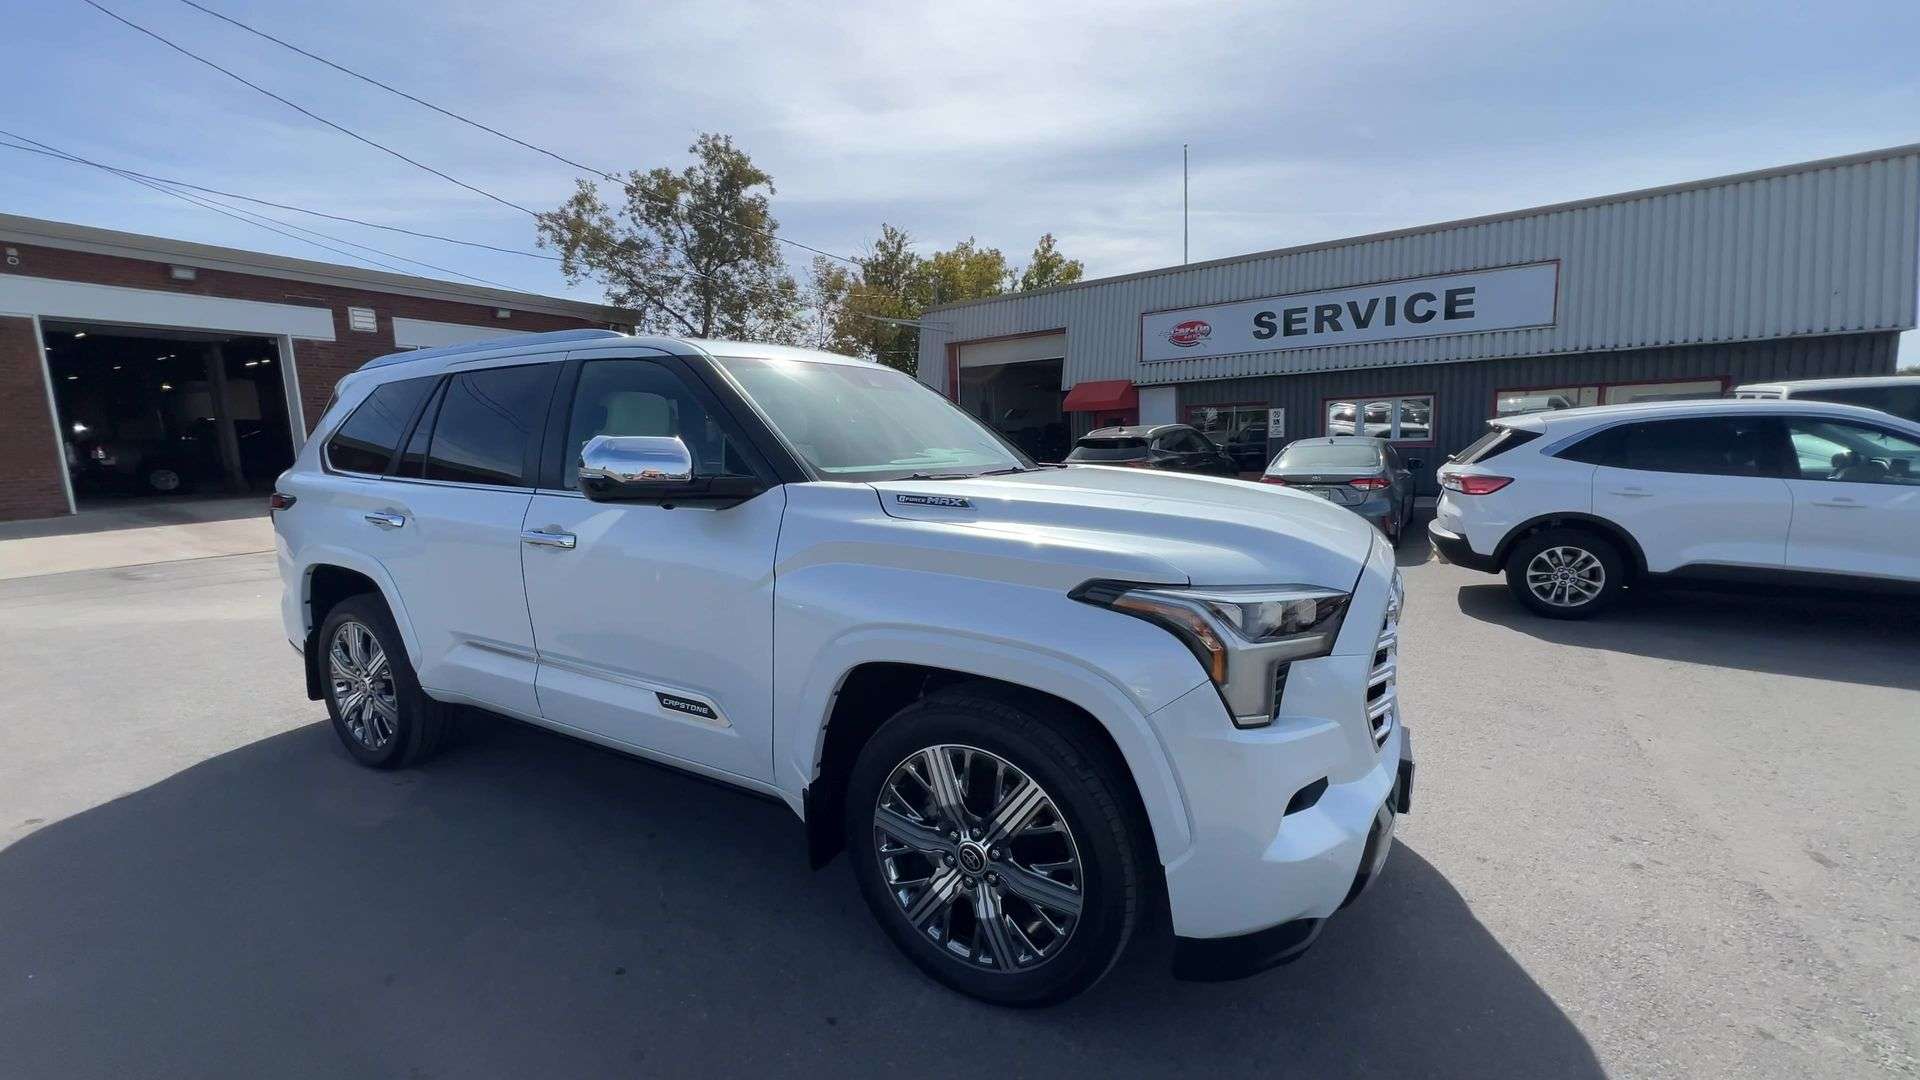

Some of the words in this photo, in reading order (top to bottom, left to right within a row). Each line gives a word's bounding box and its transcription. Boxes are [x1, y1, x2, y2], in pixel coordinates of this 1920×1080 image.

[1252, 286, 1476, 340] SERVICE
[926, 496, 963, 506] MAX
[663, 698, 708, 714] CAPSTONE
